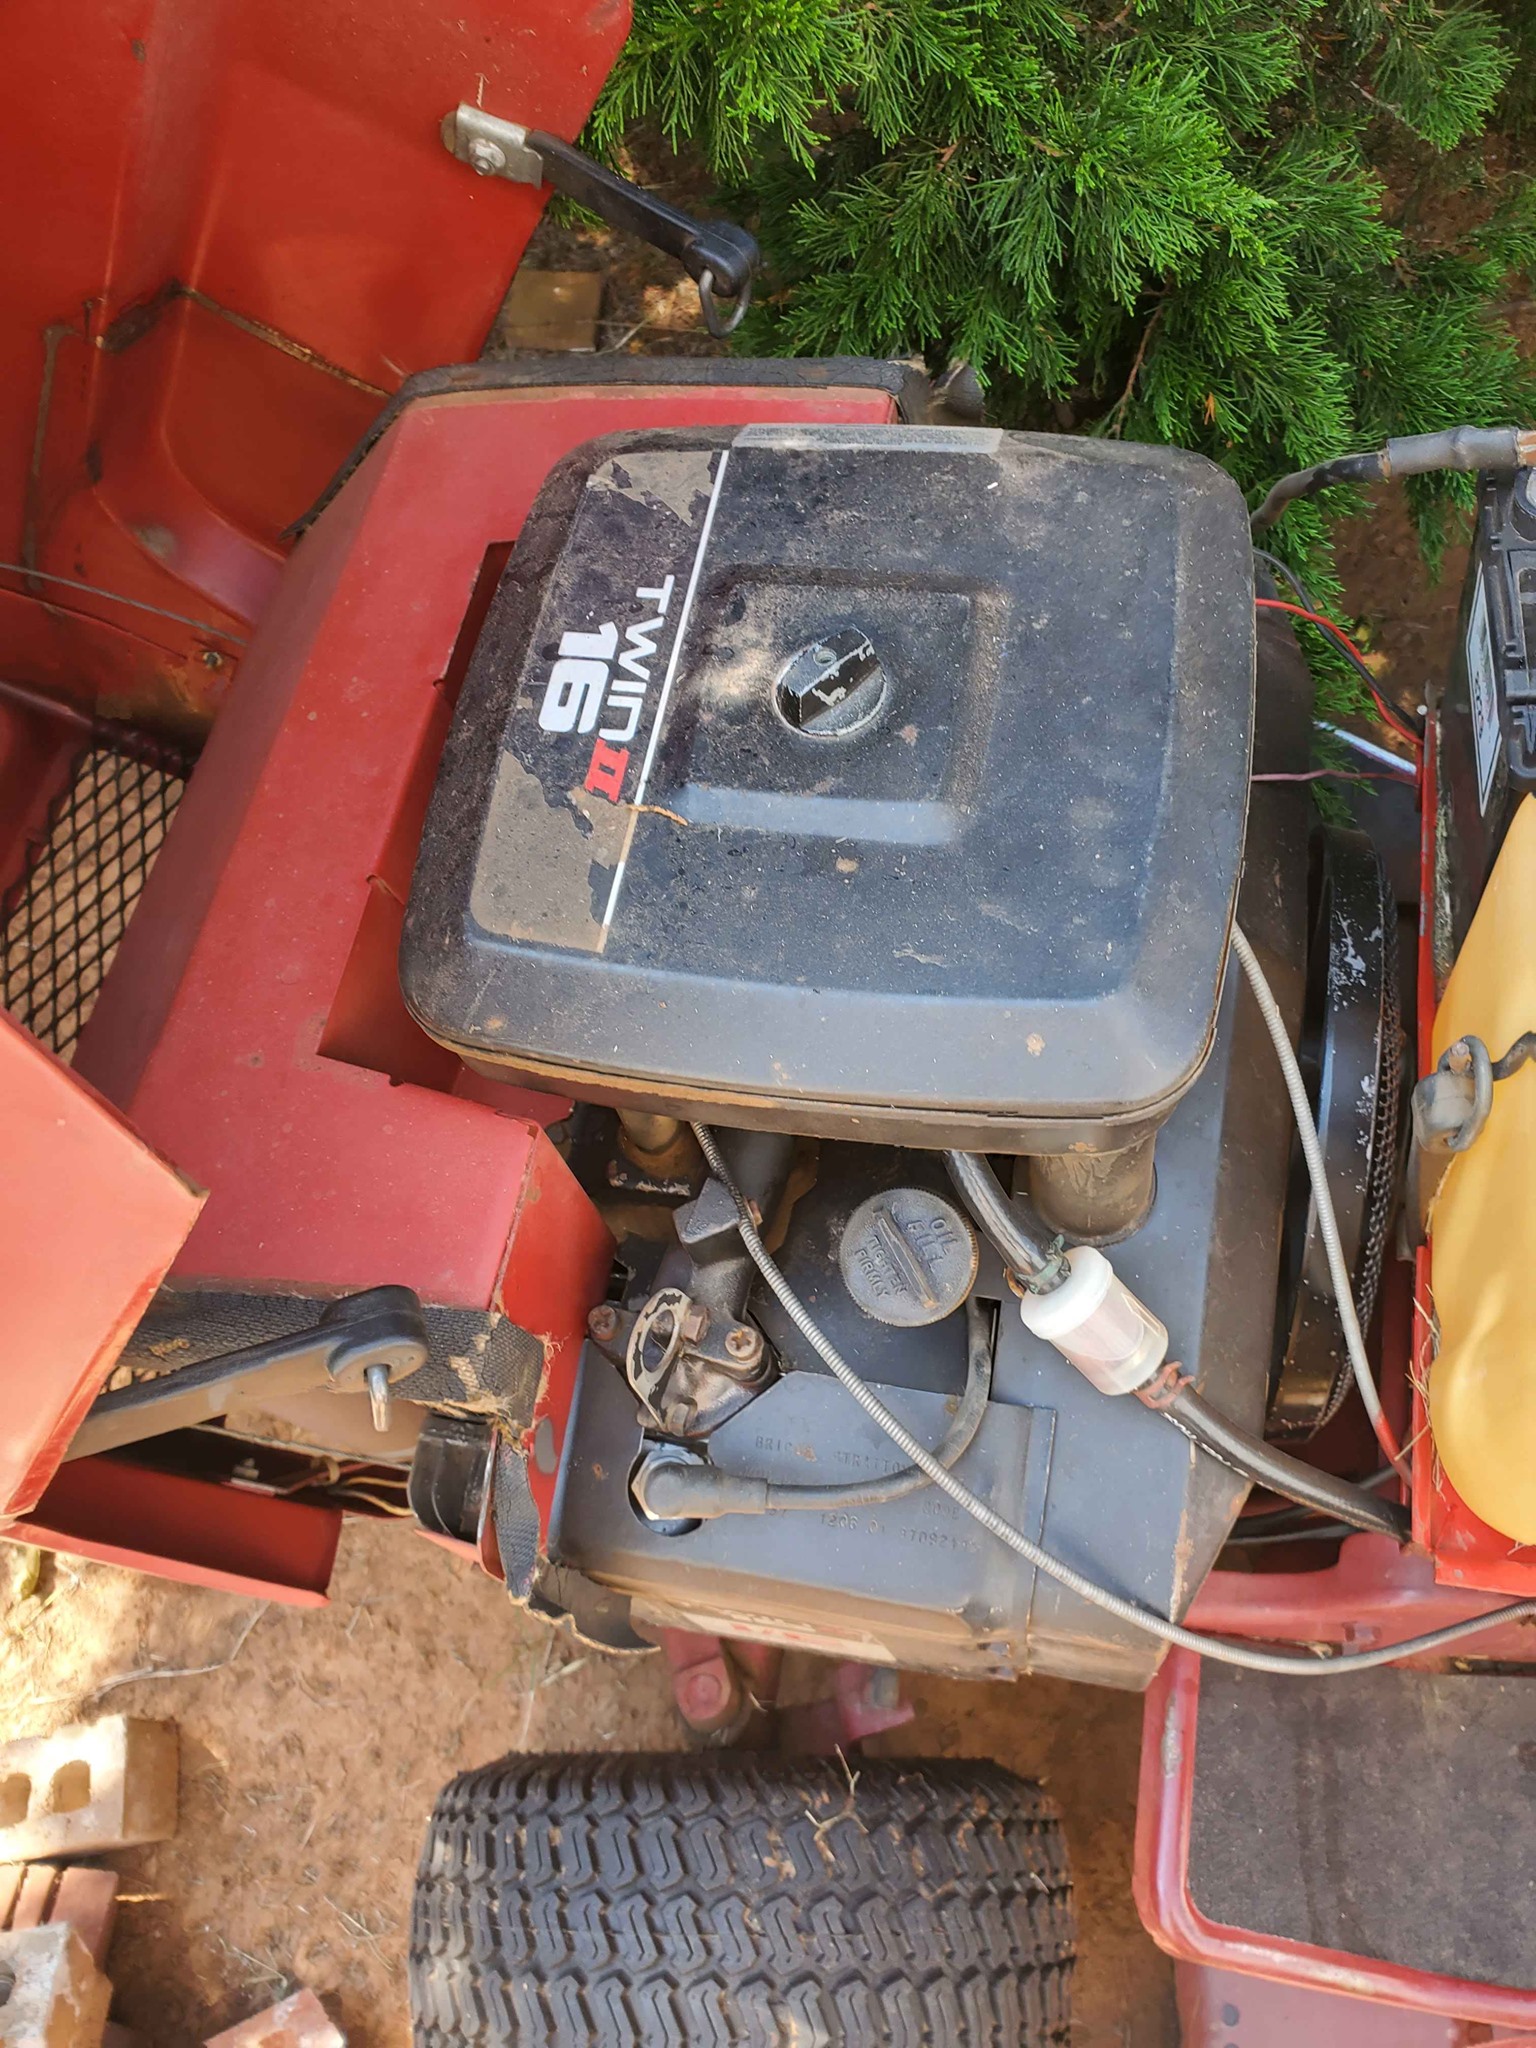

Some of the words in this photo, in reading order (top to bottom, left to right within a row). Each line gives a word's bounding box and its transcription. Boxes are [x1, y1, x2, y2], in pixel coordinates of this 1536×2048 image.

[538, 620, 619, 734] 16
[598, 574, 675, 742] TWIN
[906, 1219, 946, 1274] FILL
[929, 1217, 957, 1256] OIL
[854, 1247, 892, 1298] FIRMLY
[866, 1235, 910, 1297] TIGHTEN
[755, 1434, 816, 1462] BRIG
